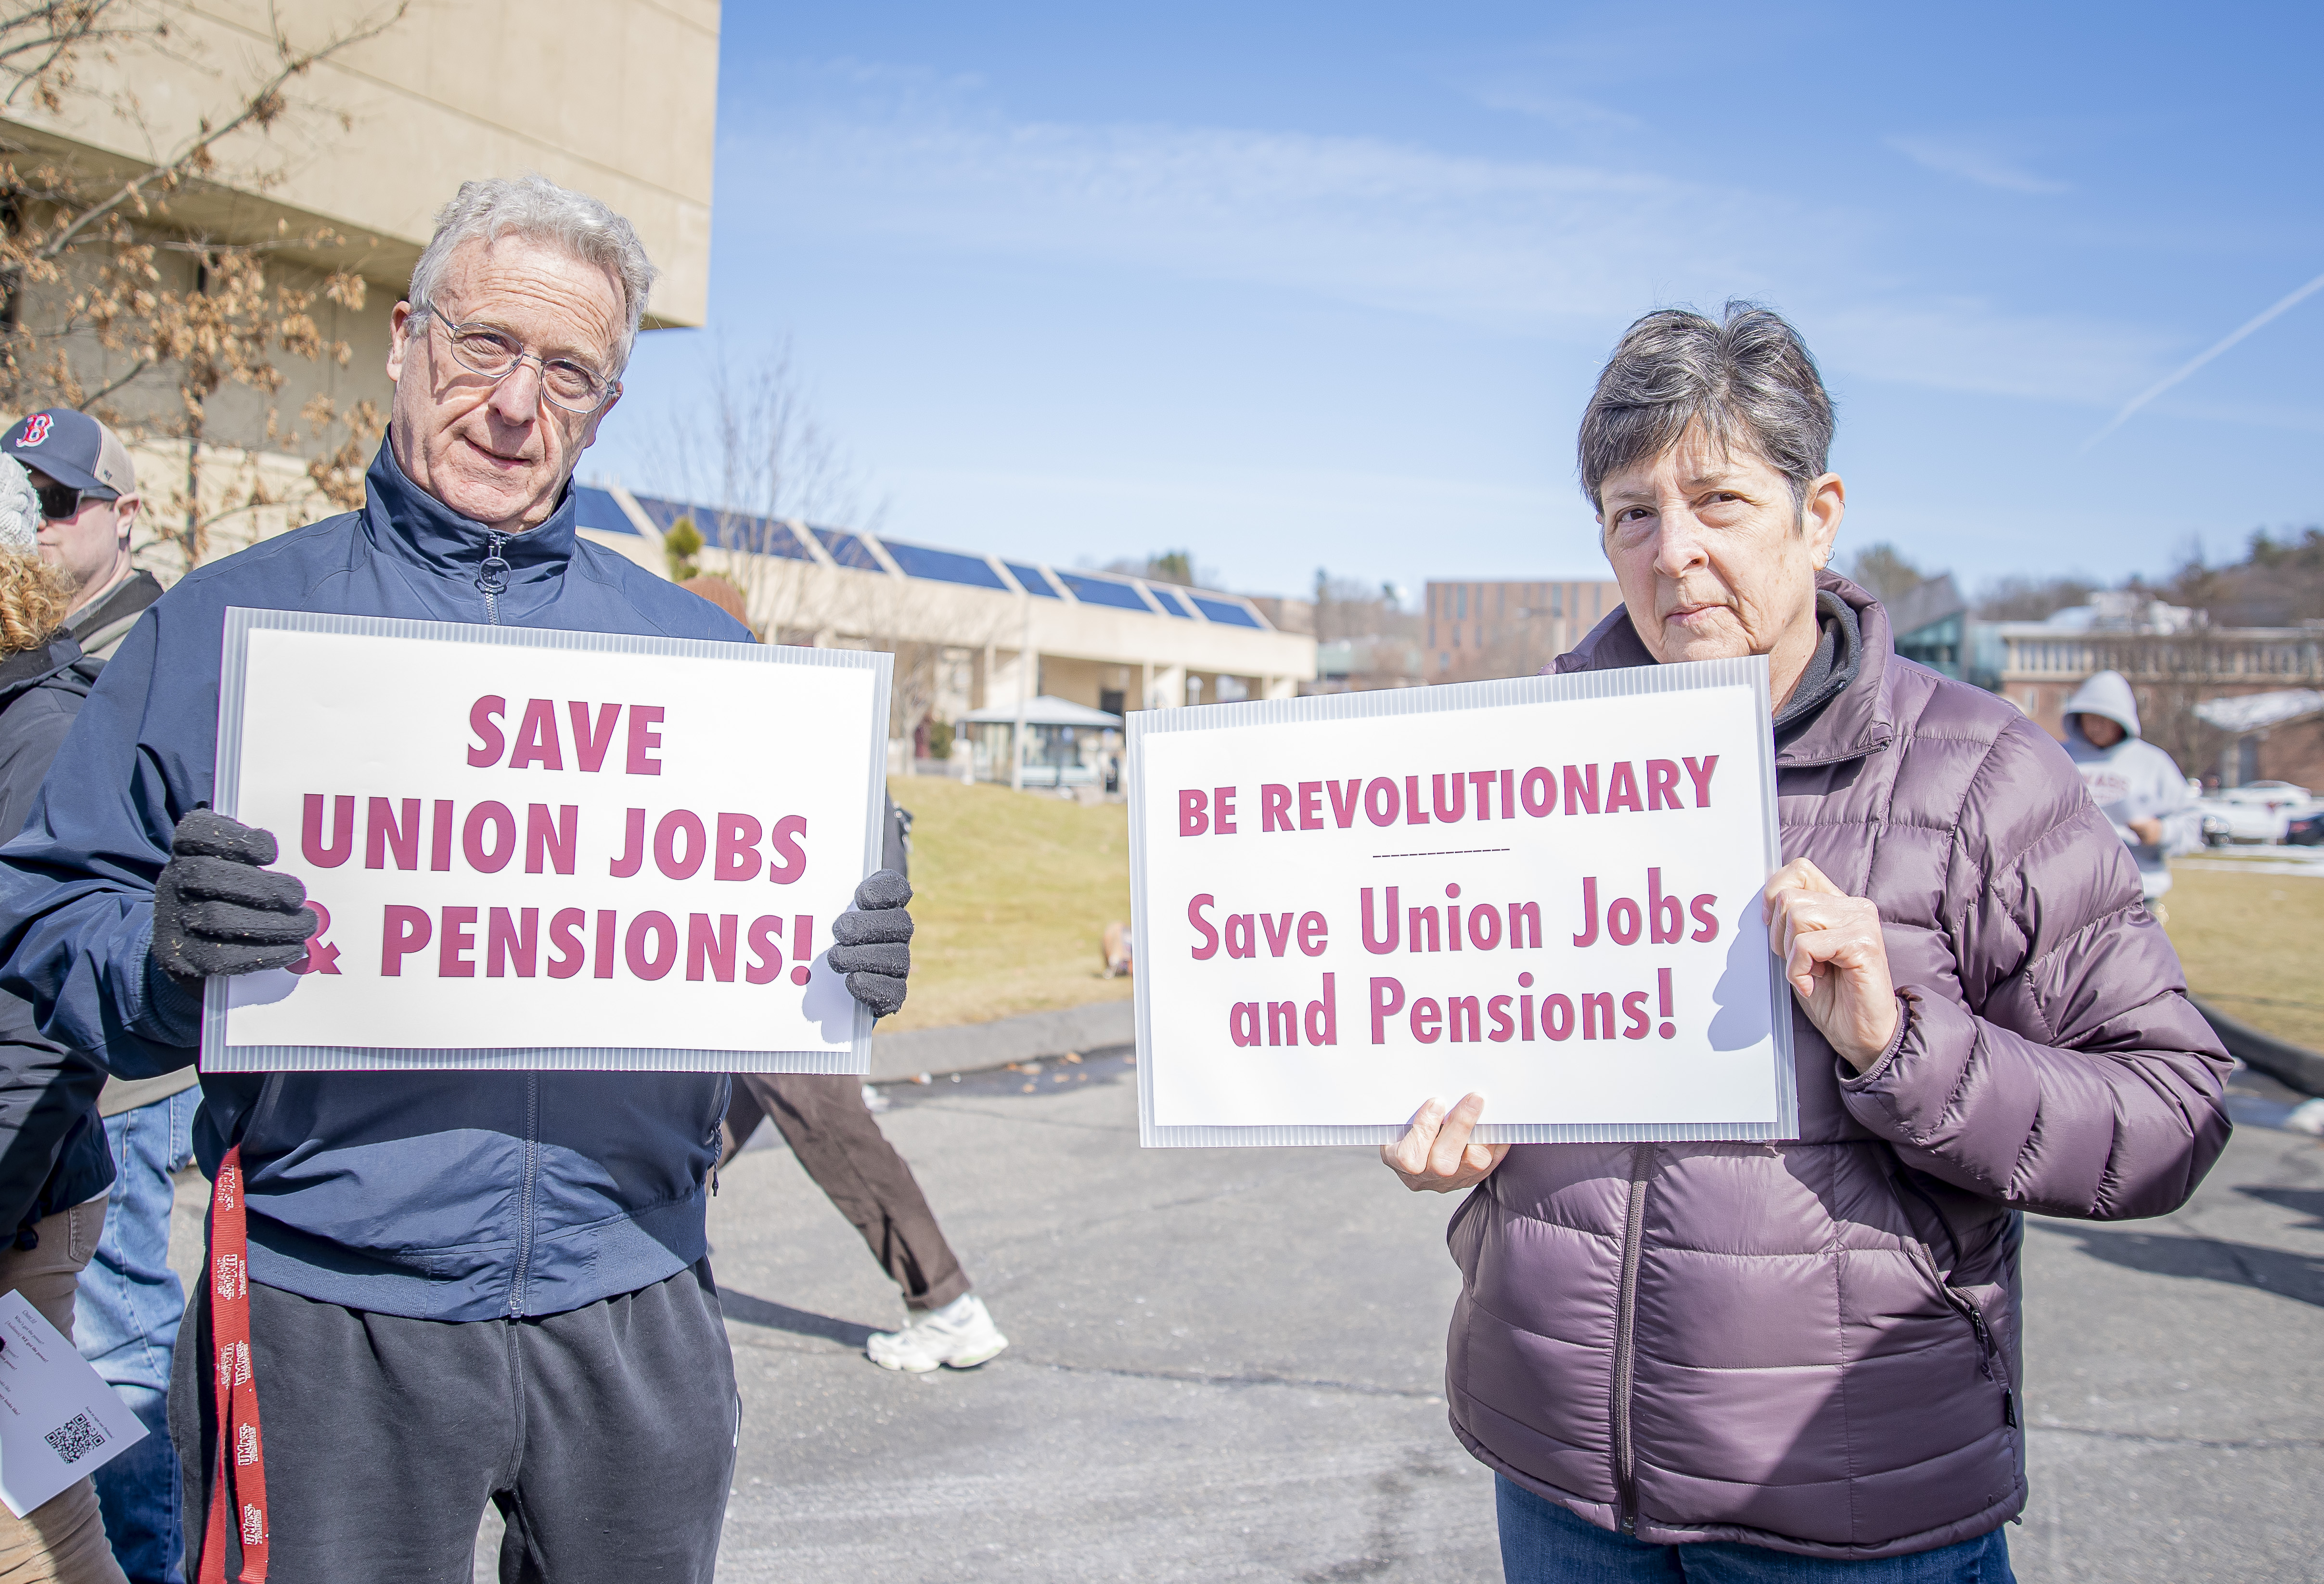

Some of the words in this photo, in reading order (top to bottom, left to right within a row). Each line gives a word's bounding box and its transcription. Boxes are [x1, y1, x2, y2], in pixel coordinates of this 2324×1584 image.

[16, 413, 54, 447] B
[467, 695, 665, 776] SAVE
[1179, 786, 1238, 837] BE
[1260, 755, 1720, 833] REVOLUTIONARY
[302, 793, 578, 876] UNION
[609, 808, 808, 885] JOBS
[381, 904, 813, 986] PENSIONS!
[1187, 893, 1329, 961] Save
[1360, 882, 1543, 955] Union
[1572, 867, 1720, 948] Jobs
[1230, 972, 1337, 1047] and
[1370, 967, 1677, 1045] Pensions!
[36, 1352, 49, 1363] power!
